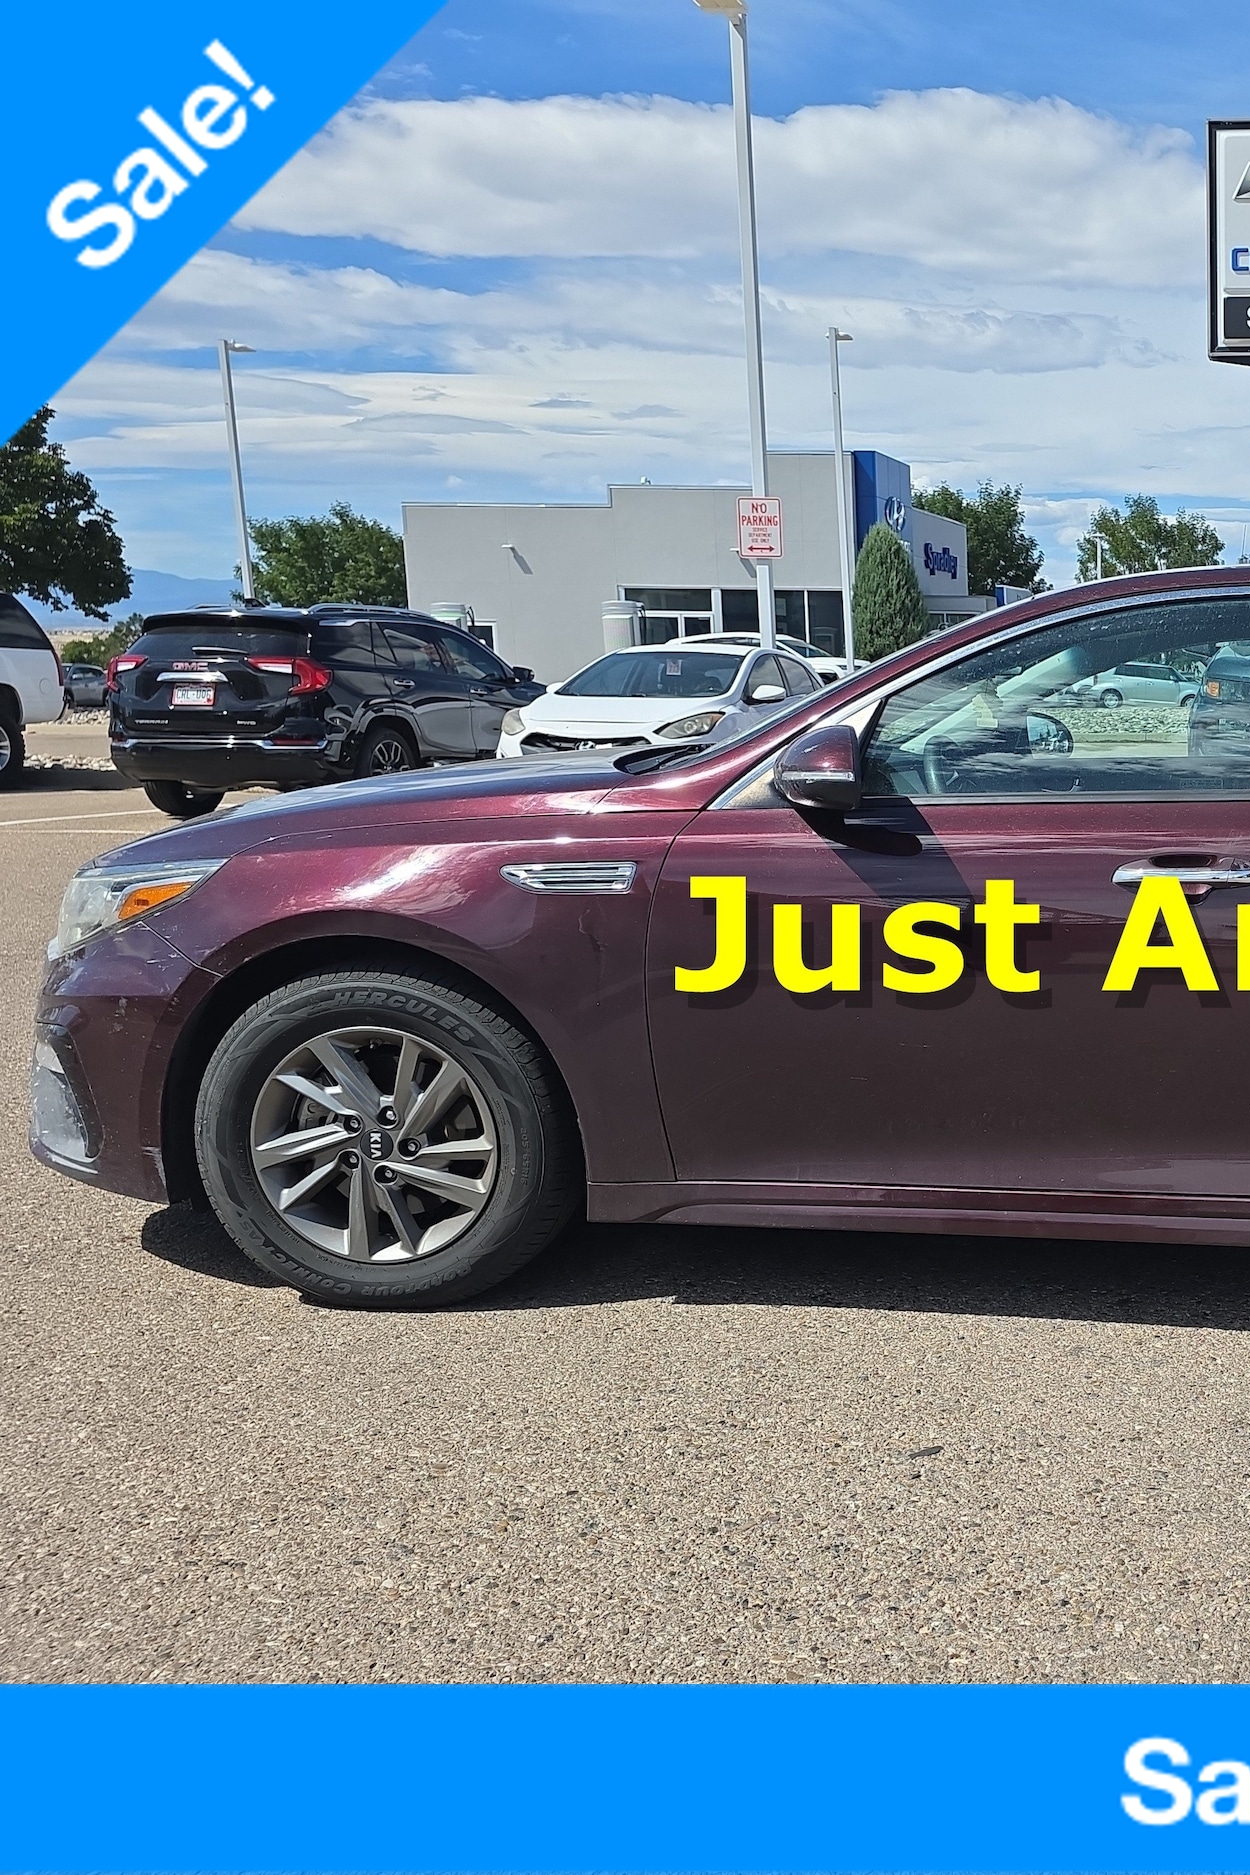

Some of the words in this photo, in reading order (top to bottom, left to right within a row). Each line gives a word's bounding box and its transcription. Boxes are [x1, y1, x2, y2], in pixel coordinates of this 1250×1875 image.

[741, 515, 779, 527] PARKING
[751, 502, 767, 514] NO
[923, 542, 958, 580] Spradley
[172, 662, 209, 671] GMC
[333, 990, 476, 1042] HERCULES
[370, 1132, 382, 1159] KIA
[258, 1238, 352, 1296] CONNECT
[360, 1257, 473, 1297] ROADTOUR
